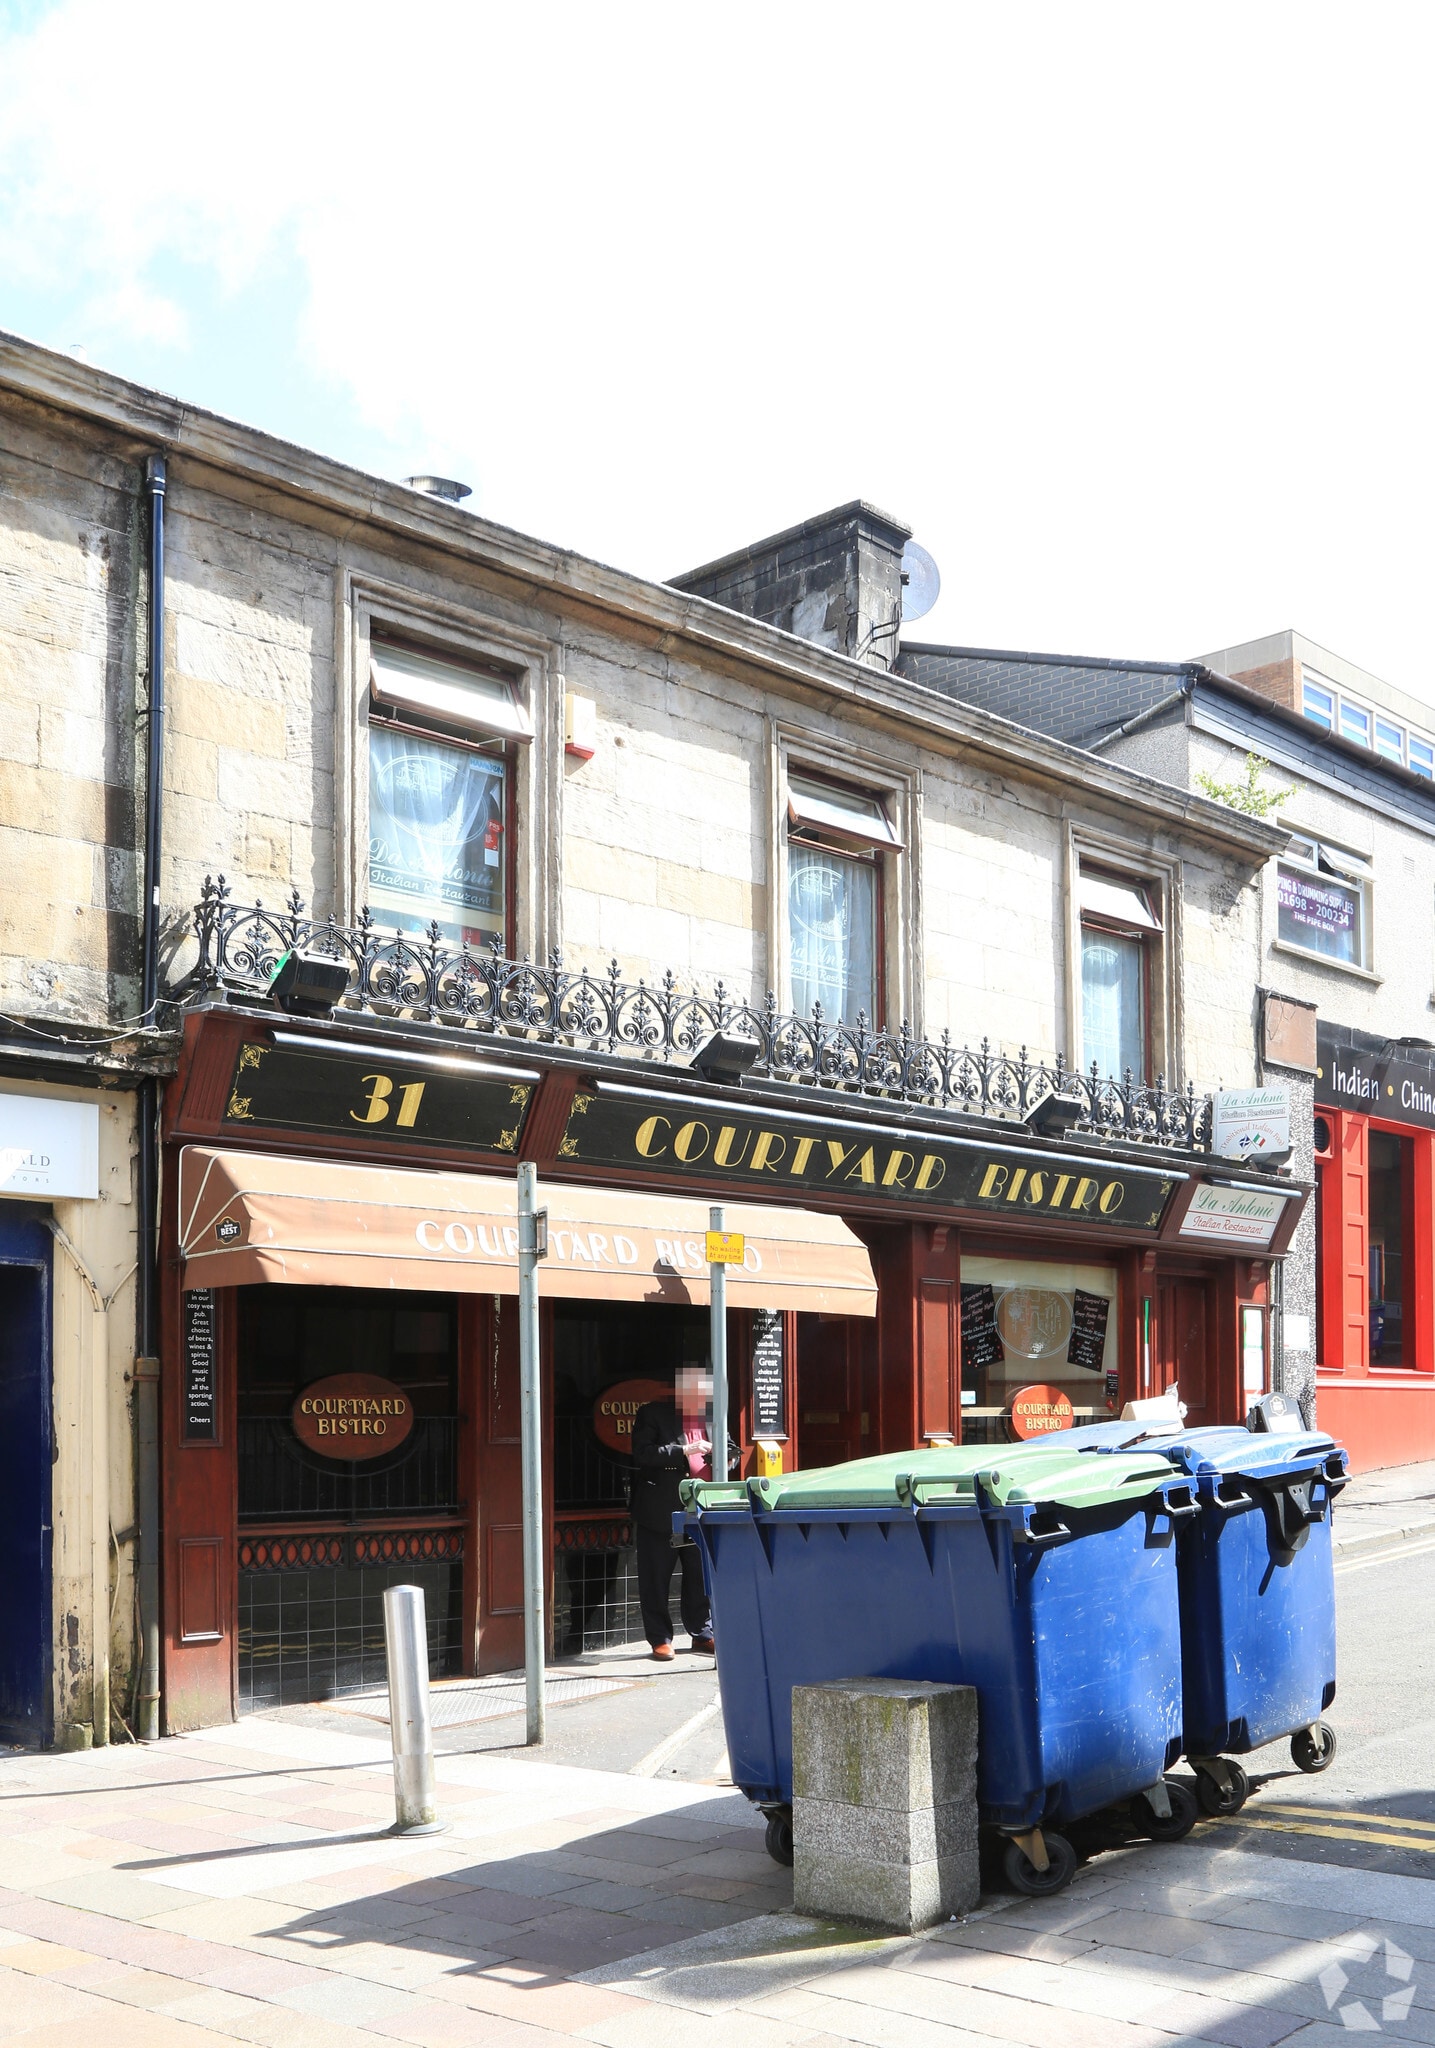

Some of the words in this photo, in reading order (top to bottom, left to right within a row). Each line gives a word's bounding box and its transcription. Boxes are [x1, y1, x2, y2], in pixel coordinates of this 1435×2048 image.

[371, 869, 419, 890] Italian
[1278, 890, 1307, 910] 01698
[1316, 904, 1349, 926] 200234
[1298, 884, 1328, 905] DRUMMING
[1329, 895, 1353, 915] SUPPLIES
[1294, 911, 1306, 922] THE
[1307, 915, 1321, 928] PIPE
[1322, 921, 1335, 932] BOX
[1332, 1061, 1379, 1101] Indian
[350, 1074, 426, 1128] 31
[1221, 1093, 1238, 1106] Da
[1241, 1091, 1284, 1105] Antonio
[1220, 1122, 1250, 1149] Traditional
[1252, 1122, 1274, 1134] Italian
[635, 1115, 947, 1190] COURTYARD
[977, 1163, 1125, 1214] BISTRO
[1196, 1188, 1218, 1209] Da
[1222, 1194, 1274, 1218] Antonio
[220, 1226, 238, 1236] BEST
[1193, 1215, 1220, 1229] Italian
[1222, 1219, 1263, 1235] Restaurant
[415, 1219, 638, 1265] COURYARD
[655, 1238, 763, 1273] BISO
[759, 1357, 777, 1366] Great
[301, 1398, 406, 1415] COURTYARD
[1016, 1403, 1071, 1417] COURTYARD
[317, 1418, 387, 1435] BISTRO
[1025, 1418, 1062, 1431] BISTRO
